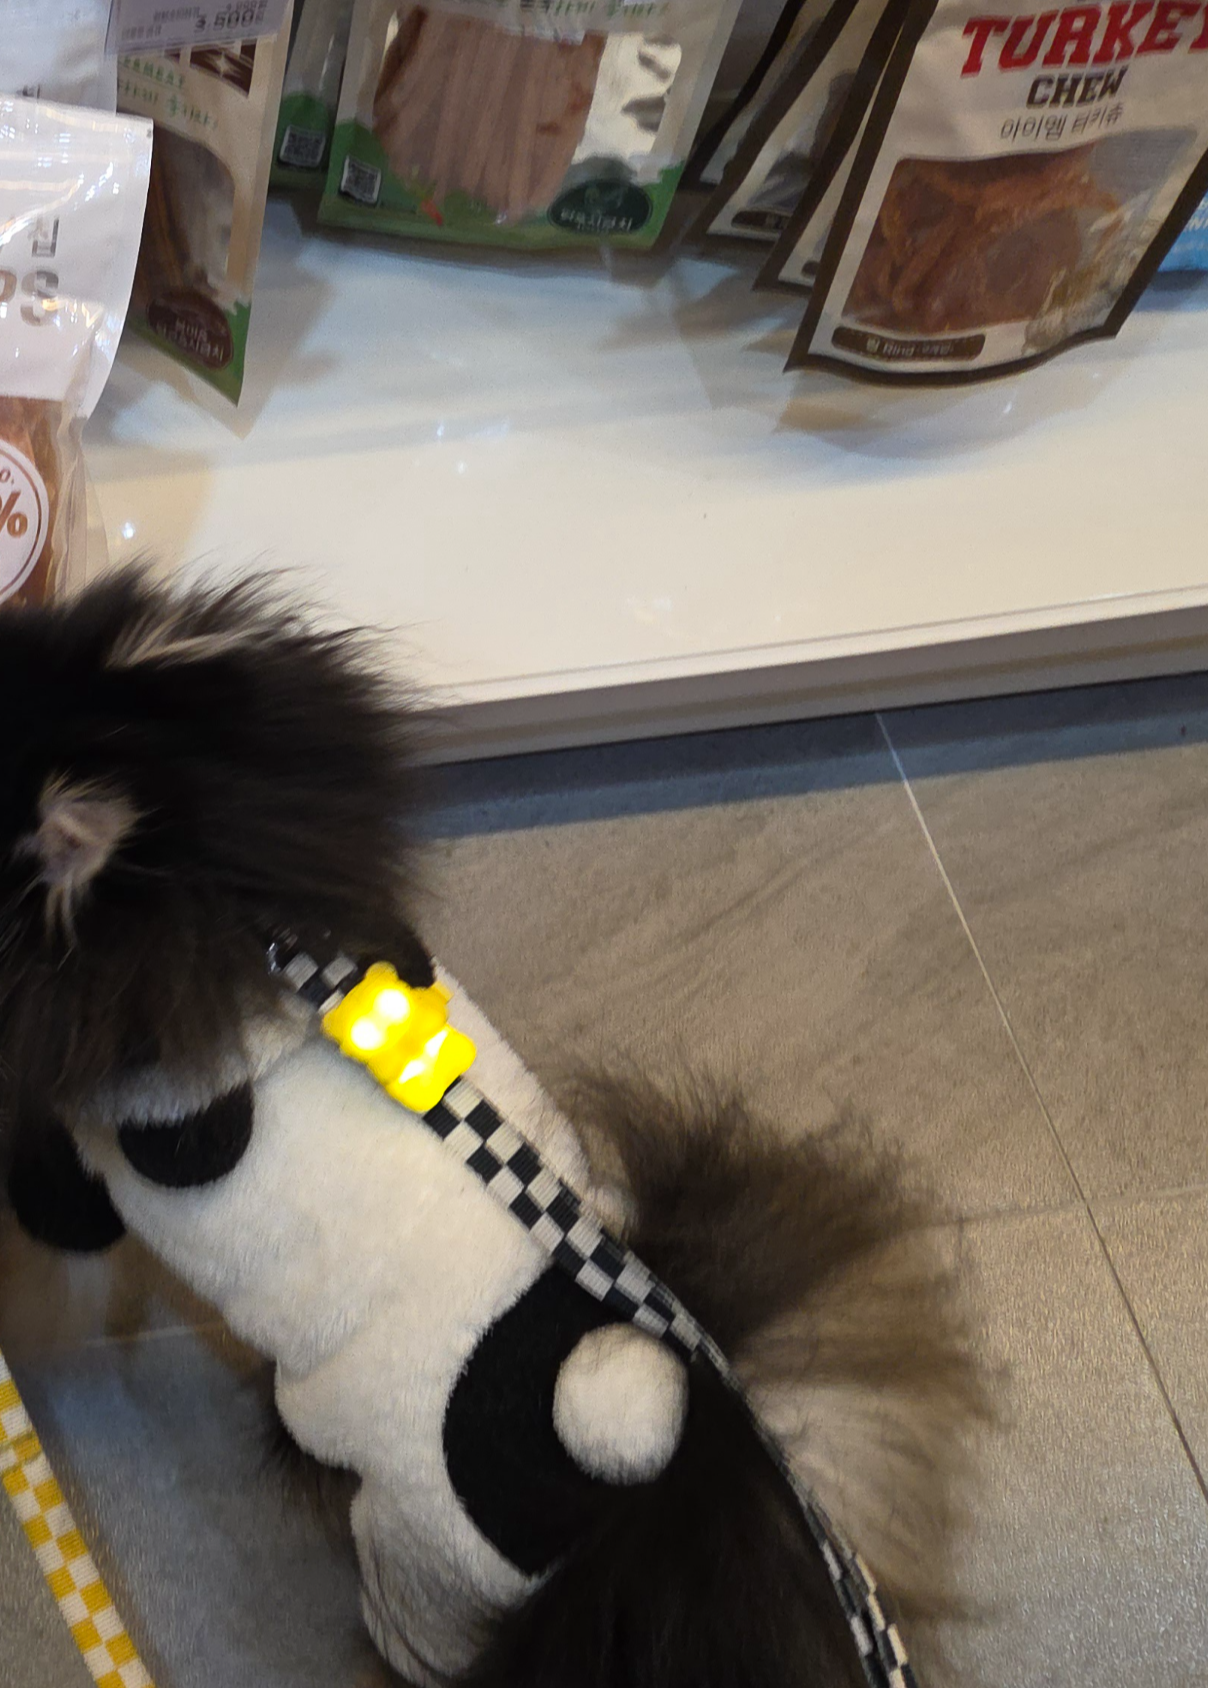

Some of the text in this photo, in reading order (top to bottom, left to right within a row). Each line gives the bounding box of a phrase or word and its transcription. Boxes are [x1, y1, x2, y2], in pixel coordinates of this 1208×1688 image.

[1025, 65, 1129, 109] CHEW
[999, 103, 1124, 142] 아이엠 터키츄
